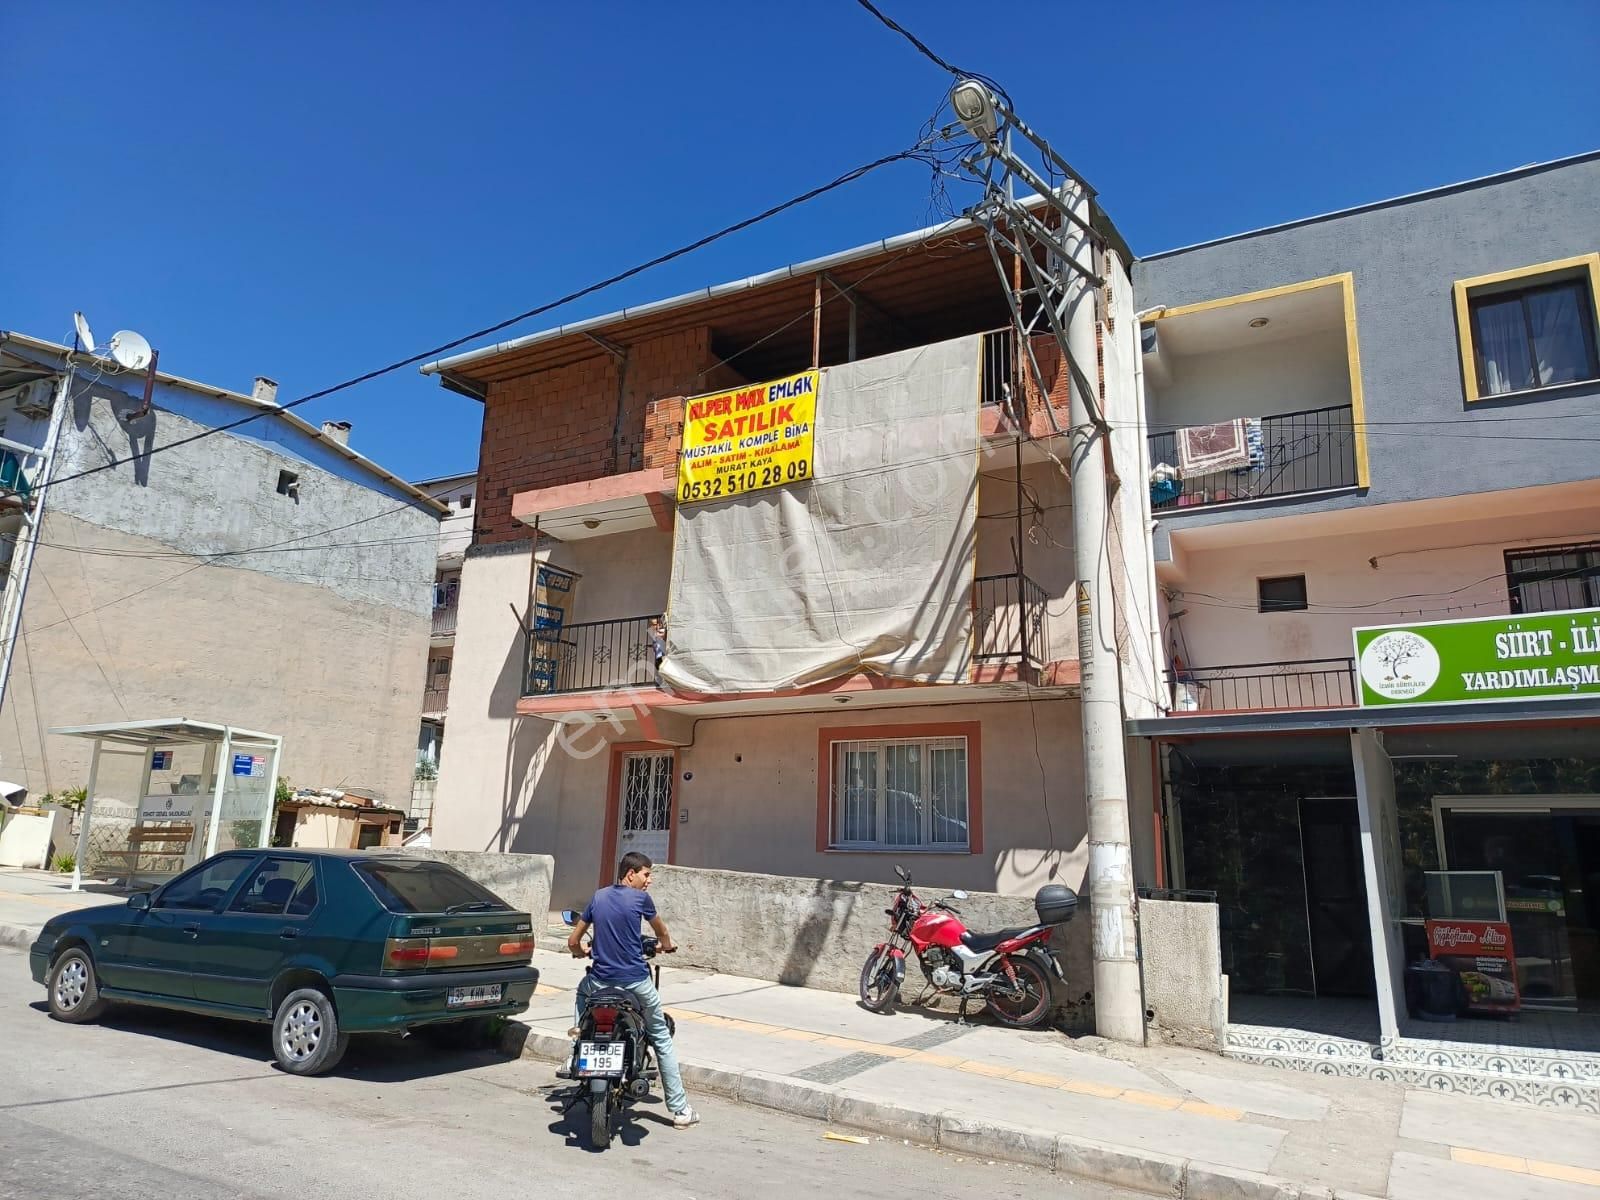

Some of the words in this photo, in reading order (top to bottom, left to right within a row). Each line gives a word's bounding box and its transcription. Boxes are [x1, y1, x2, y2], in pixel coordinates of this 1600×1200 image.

[689, 395, 732, 422] ALPER
[735, 387, 766, 411] MAX
[768, 376, 813, 402] EMLAK
[703, 403, 796, 442] SATILIK
[739, 430, 779, 449] KOMPLE
[784, 423, 809, 438] BİNA
[691, 460, 712, 470] ALIM
[719, 452, 747, 464] SATIM
[716, 462, 747, 474] MURAT
[750, 457, 773, 468] KAYA
[682, 478, 722, 499] 0532
[727, 471, 757, 493] 510
[762, 465, 782, 486] 28
[787, 459, 807, 480] 09
[1495, 623, 1553, 659] SİİRT
[454, 988, 465, 1001] 35
[583, 1045, 596, 1056] 35
[593, 1057, 612, 1069] 195
